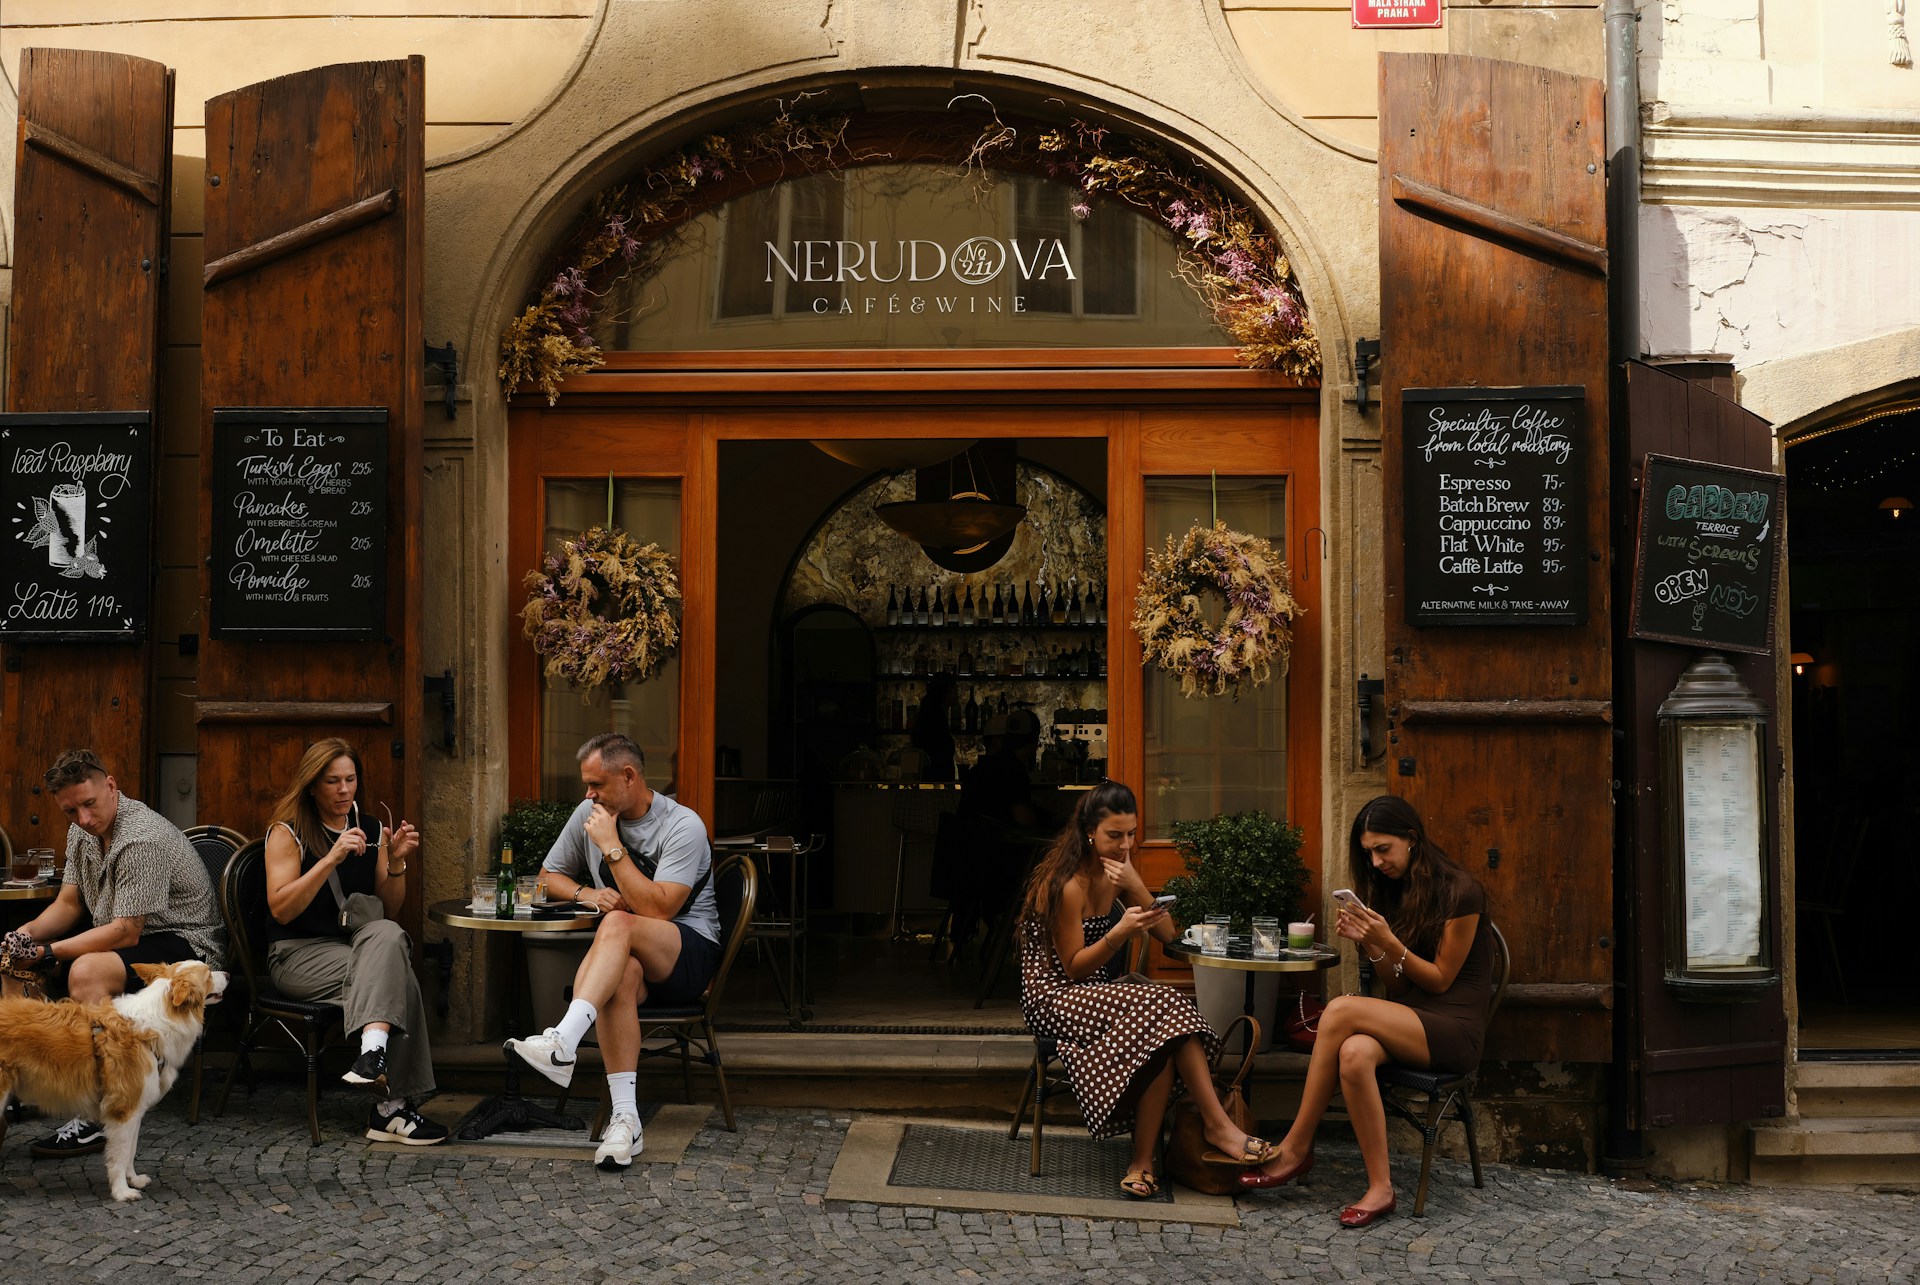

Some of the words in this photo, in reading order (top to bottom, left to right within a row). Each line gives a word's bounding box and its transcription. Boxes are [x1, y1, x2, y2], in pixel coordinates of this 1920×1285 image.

[1377, 8, 1409, 18] PRAHA
[1412, 7, 1417, 17] 1
[962, 260, 993, 277] 211
[1428, 406, 1510, 443] Specialty
[1512, 404, 1565, 444] Coffee
[261, 428, 283, 447] To
[293, 428, 326, 447] Eat
[1417, 434, 1465, 463] from
[1467, 431, 1510, 455] local
[1511, 433, 1573, 464] roastery
[11, 447, 48, 473] Iced
[49, 441, 132, 500] Raspberry
[236, 453, 296, 480] Turkish
[297, 455, 341, 490] Eggs
[247, 477, 269, 486] WITH
[325, 479, 352, 487] HERBS
[308, 485, 315, 494] &
[320, 486, 346, 495] BREAD
[1439, 474, 1511, 494] Espresso
[233, 491, 310, 520] Pancakes
[1439, 495, 1484, 513] Batch
[1486, 495, 1530, 513] Brew
[1665, 484, 1769, 524] GARDEN
[1439, 515, 1531, 536] Cappuccino
[1695, 521, 1741, 535] TERRACE
[235, 527, 323, 558] Omelette
[1440, 535, 1468, 553] Flat
[1474, 535, 1525, 553] White
[1657, 535, 1688, 548] WITH
[1484, 556, 1524, 574] Latte
[229, 561, 310, 602] Porridge
[1655, 568, 1709, 603] OPEN
[8, 582, 79, 619] Latte
[293, 593, 300, 602] &
[1421, 601, 1476, 610] ALTERNATIVE
[1478, 601, 1500, 610] MILK
[1710, 584, 1758, 615] NOW
